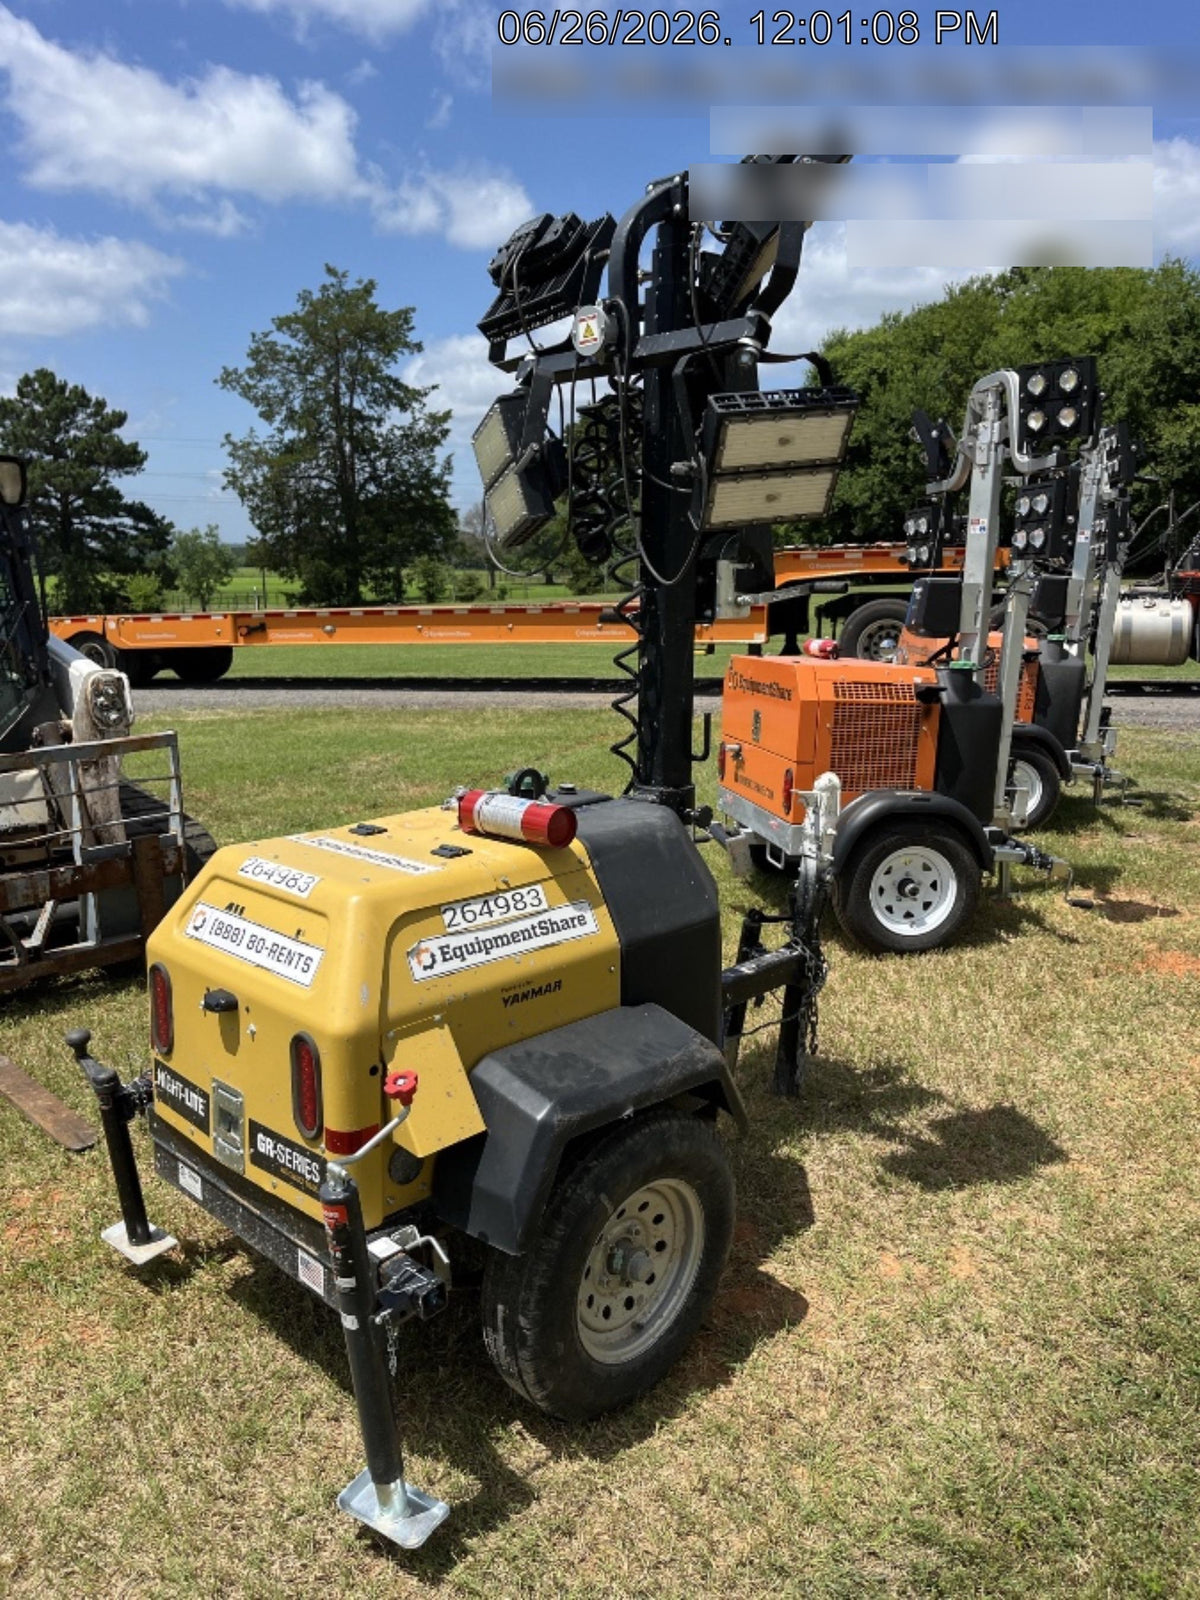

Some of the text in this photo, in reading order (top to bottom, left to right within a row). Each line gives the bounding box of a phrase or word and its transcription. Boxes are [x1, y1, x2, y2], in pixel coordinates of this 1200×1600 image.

[239, 857, 316, 894] 264983
[441, 887, 544, 929] 264983
[208, 917, 314, 974] (888) 80-RENTS
[438, 913, 588, 963] EquipmentShare
[502, 979, 563, 1009] YANMAR
[256, 1132, 320, 1183] GR-SERIES
